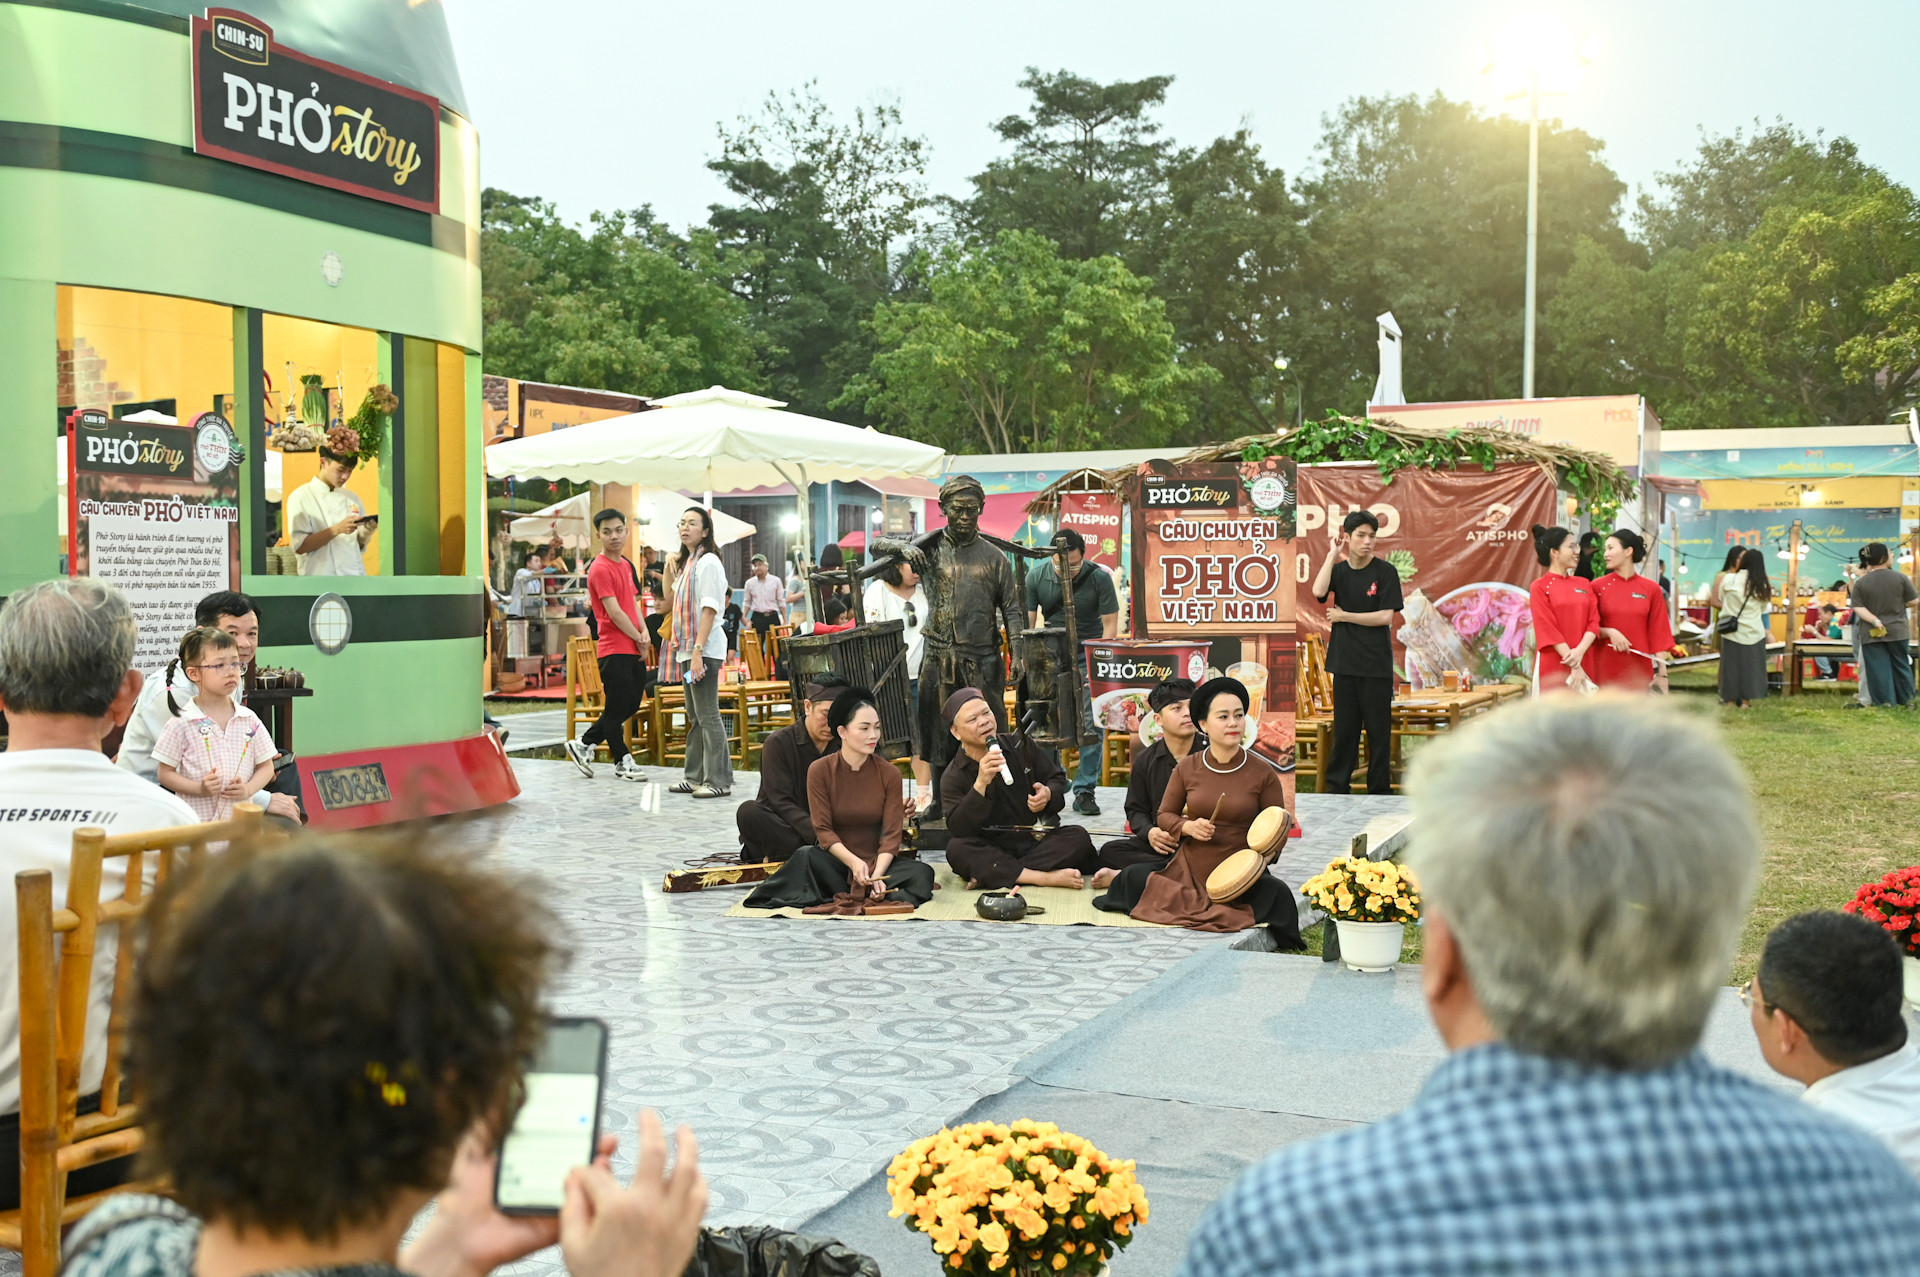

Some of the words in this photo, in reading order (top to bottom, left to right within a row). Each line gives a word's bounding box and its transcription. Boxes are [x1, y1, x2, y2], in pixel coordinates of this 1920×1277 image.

[217, 23, 264, 52] CHIN-SU
[223, 72, 332, 154] PHỞ
[331, 105, 421, 185] story
[84, 415, 105, 424] CHIN-SU
[86, 431, 139, 465] PHỞ
[138, 438, 184, 472] story
[1148, 483, 1191, 504] PHỞ
[1190, 485, 1230, 505] story
[80, 500, 99, 515] CÂU
[103, 501, 140, 518] CHUYỆN
[144, 496, 183, 522] PHỞ
[186, 504, 211, 521] VIỆT
[214, 508, 237, 520] NAM
[1062, 512, 1119, 526] ATISPHO
[96, 532, 108, 540] Phở
[110, 532, 126, 542] Story
[212, 535, 223, 544] phở
[1162, 520, 1197, 538] CÂU
[1202, 519, 1275, 541] CHUYỆN
[1466, 529, 1529, 541] ATISPHO
[177, 557, 189, 565] Phở
[1161, 543, 1279, 596] PHỞ
[99, 570, 111, 578] qua
[112, 568, 117, 577] 3
[145, 612, 162, 622] Story
[1162, 600, 1214, 623] VIỆT
[1225, 603, 1274, 619] NAM
[1097, 659, 1137, 679] PHỞ
[1136, 661, 1172, 681] story
[29, 809, 92, 822] SPORTS
